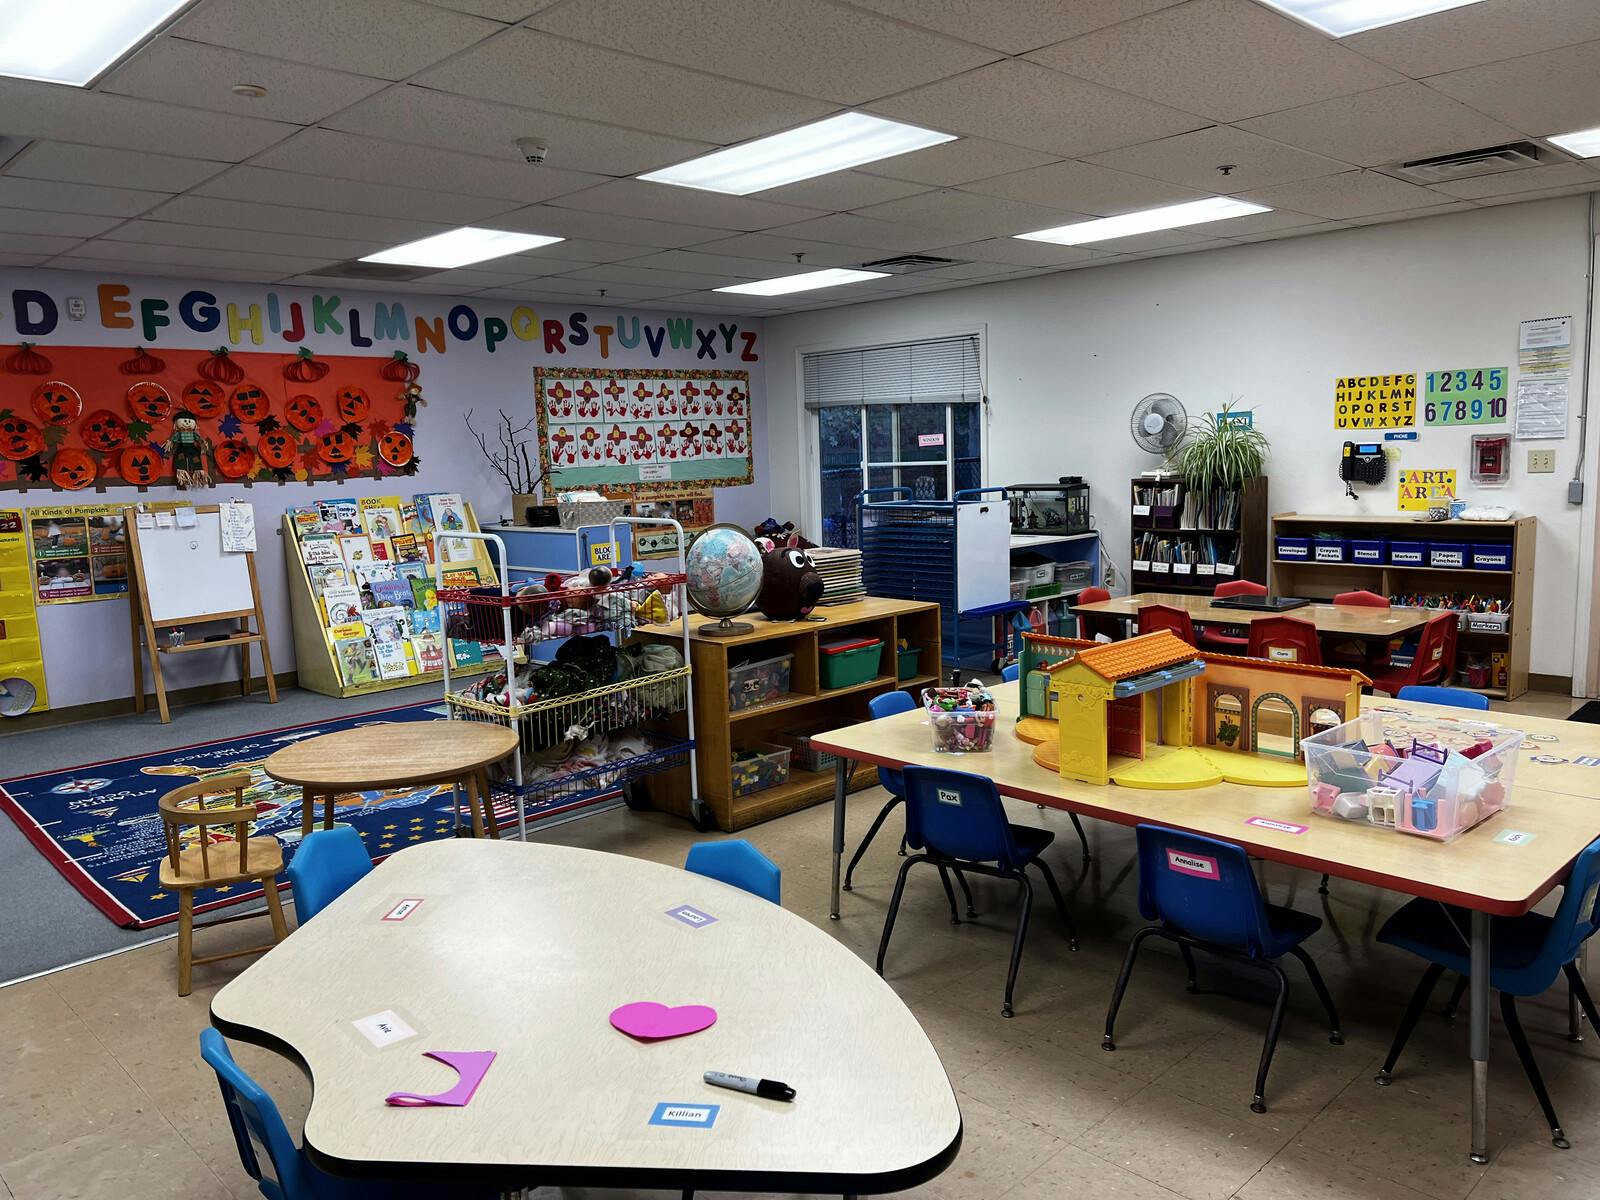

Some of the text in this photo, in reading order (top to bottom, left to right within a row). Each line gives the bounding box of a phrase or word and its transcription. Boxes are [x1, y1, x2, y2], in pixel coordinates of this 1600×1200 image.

[1427, 370, 1501, 392] 1 2 3 4 5
[1425, 398, 1506, 422] 6 7 8 9 10
[1408, 471, 1448, 484] ART
[1401, 486, 1455, 499] AREA
[68, 789, 156, 810] ATLANTIC
[941, 792, 958, 802] Pax
[1175, 856, 1204, 869] Annalise
